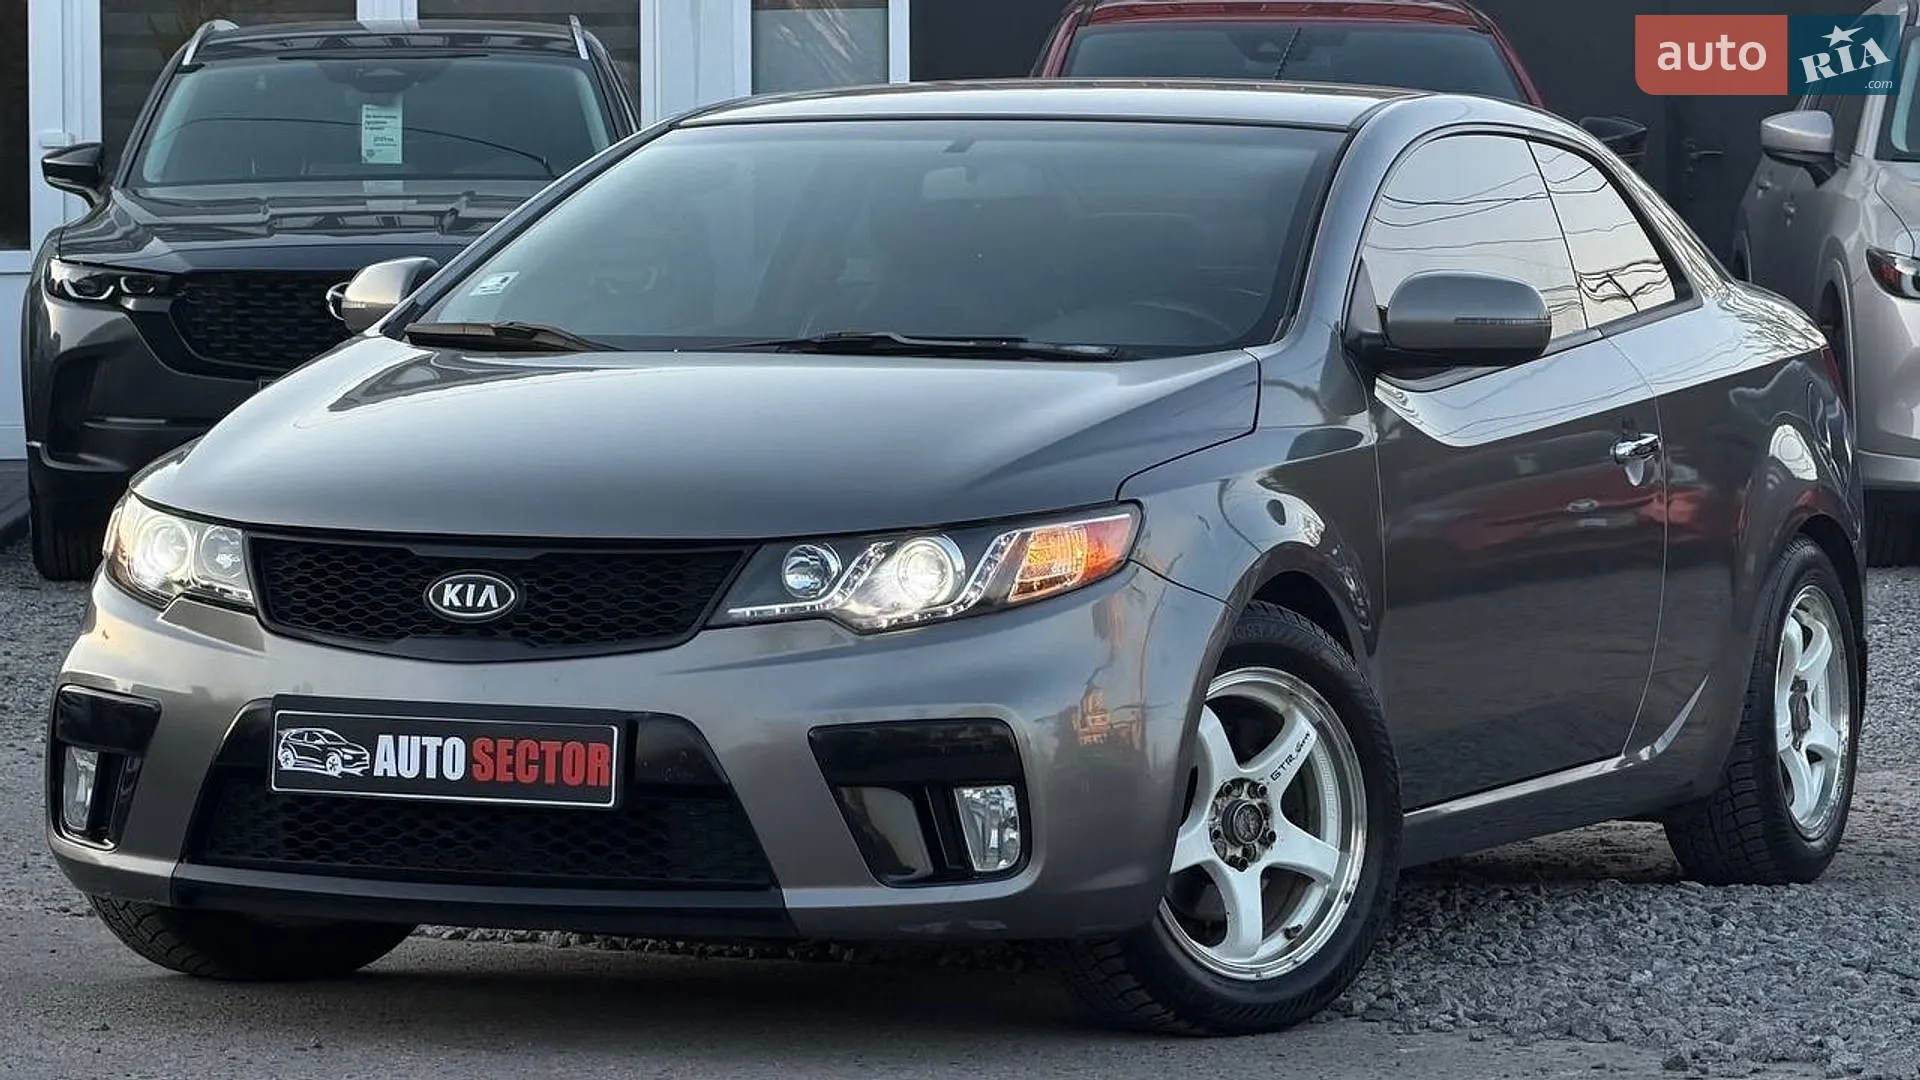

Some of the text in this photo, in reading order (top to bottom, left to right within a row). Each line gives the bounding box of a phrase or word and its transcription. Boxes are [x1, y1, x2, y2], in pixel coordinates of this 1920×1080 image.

[442, 583, 499, 608] KIA
[373, 734, 610, 786] AUTO SECTOR
